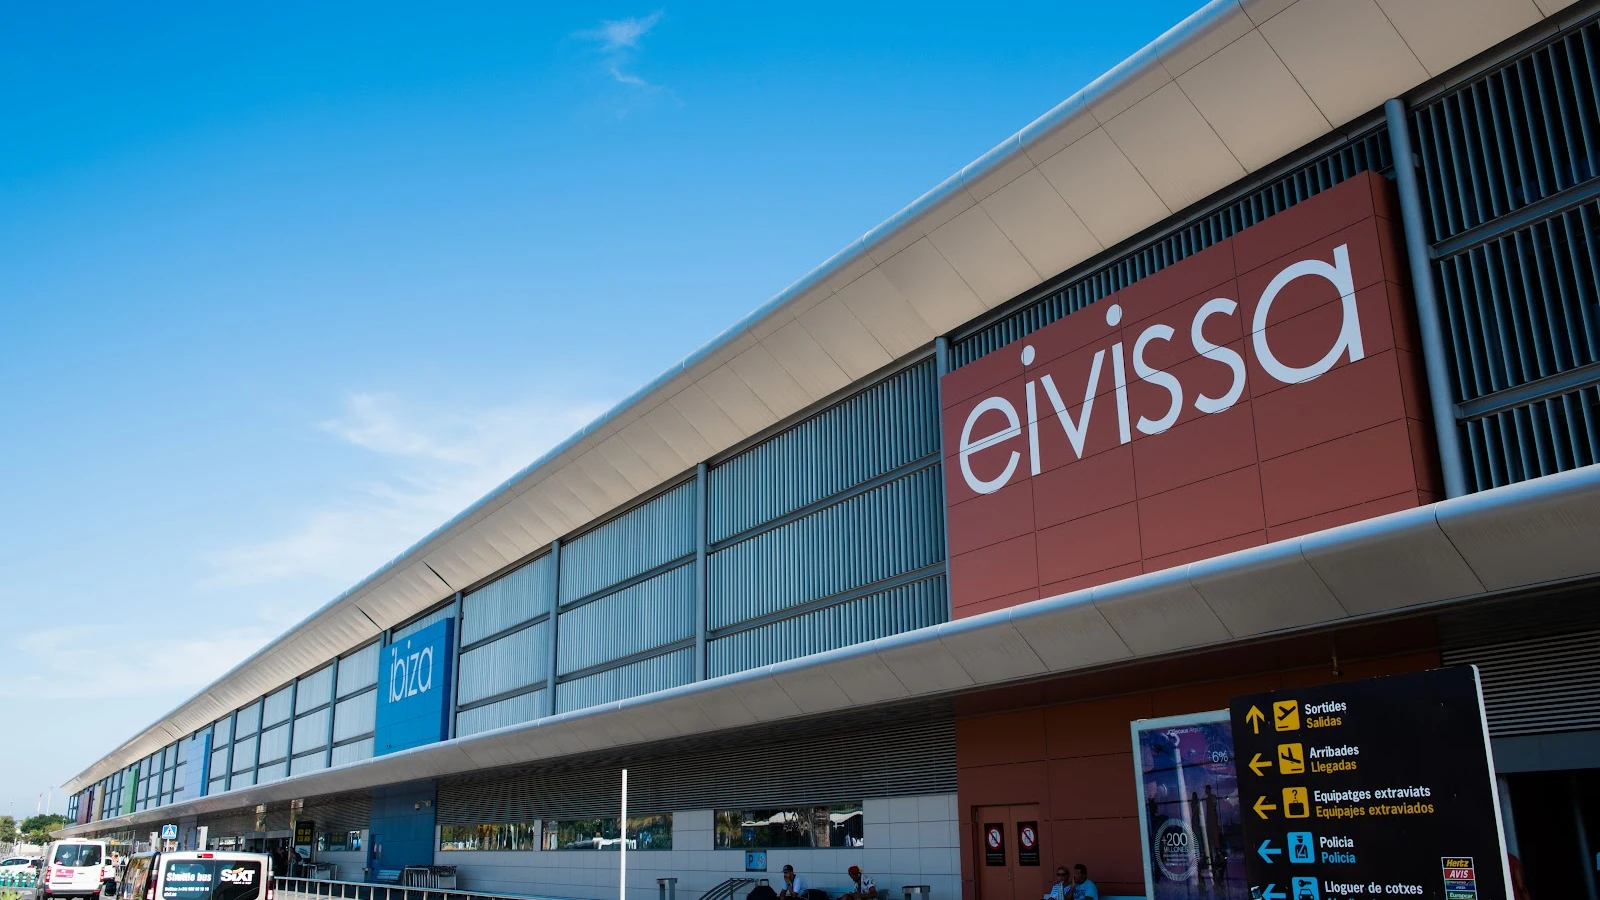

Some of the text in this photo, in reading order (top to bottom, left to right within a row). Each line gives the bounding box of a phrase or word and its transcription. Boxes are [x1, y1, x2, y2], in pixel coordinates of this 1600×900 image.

[959, 242, 1365, 494] eivissa
[388, 639, 434, 704] ibiza
[1304, 700, 1347, 715] Sortides
[1306, 715, 1342, 729] Salidas
[1309, 744, 1360, 759] Arribades
[1310, 759, 1357, 774] Llegadas
[1313, 785, 1431, 803] Equipatges extraviats
[1315, 801, 1435, 819] Equipajes extraviados
[1161, 832, 1188, 847] +200
[1319, 835, 1354, 848] Policia
[1321, 851, 1356, 864] Policía
[1446, 859, 1470, 868] Hertz
[198, 872, 212, 882] bus
[1449, 869, 1469, 879] AVIS
[1324, 880, 1424, 895] Lloguer de cotxes
